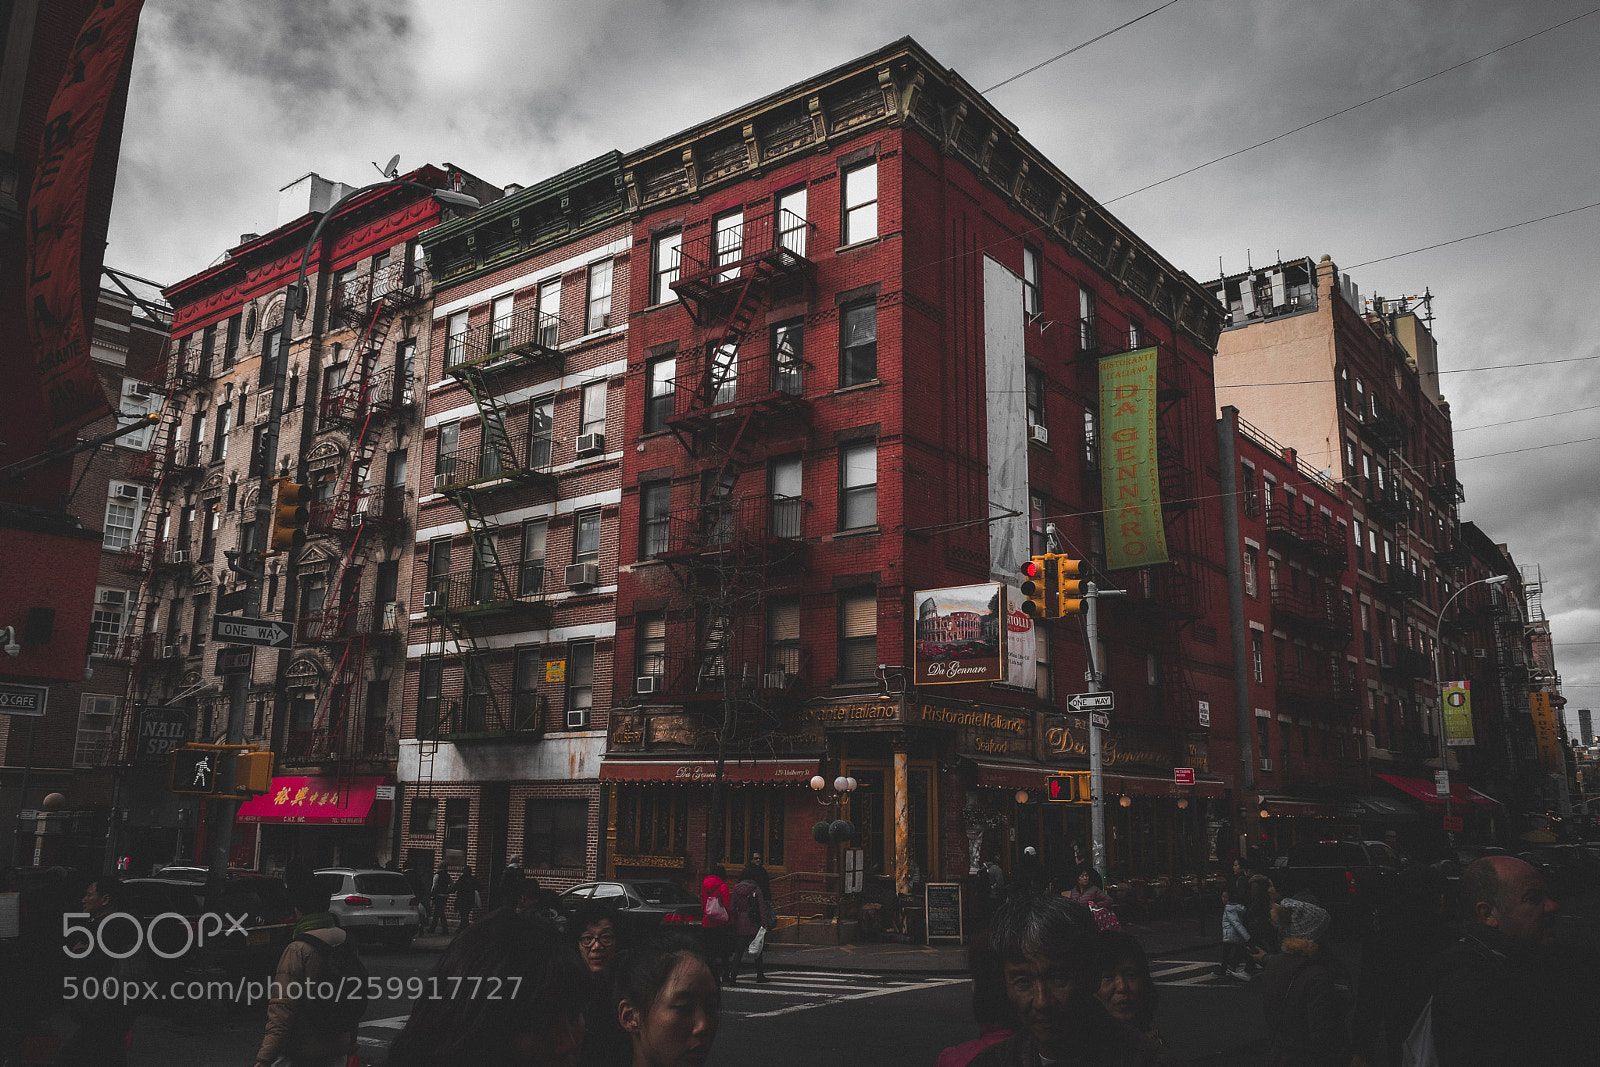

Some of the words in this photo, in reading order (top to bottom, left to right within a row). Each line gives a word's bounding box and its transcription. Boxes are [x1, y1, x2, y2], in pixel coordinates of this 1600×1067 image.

[30, 111, 73, 339] BELLA
[1101, 353, 1155, 370] RISTORANTE
[1106, 366, 1148, 380] ITALIANO
[1113, 384, 1140, 417] DA
[1110, 427, 1147, 556] GENNARO
[1007, 615, 1029, 628] RTOLLI
[224, 624, 248, 636] ONE
[258, 628, 282, 640] WAY
[927, 662, 946, 676] Da
[946, 660, 988, 678] Gennaro
[10, 696, 35, 706] CAFE
[1095, 697, 1109, 705] WAY
[921, 704, 982, 727] Ristorante
[983, 712, 1022, 732] Italiano
[142, 721, 185, 738] NAIL
[146, 738, 178, 755] SPA
[975, 737, 1008, 754] Seafood
[1045, 727, 1087, 754] Da
[675, 766, 691, 778] Da
